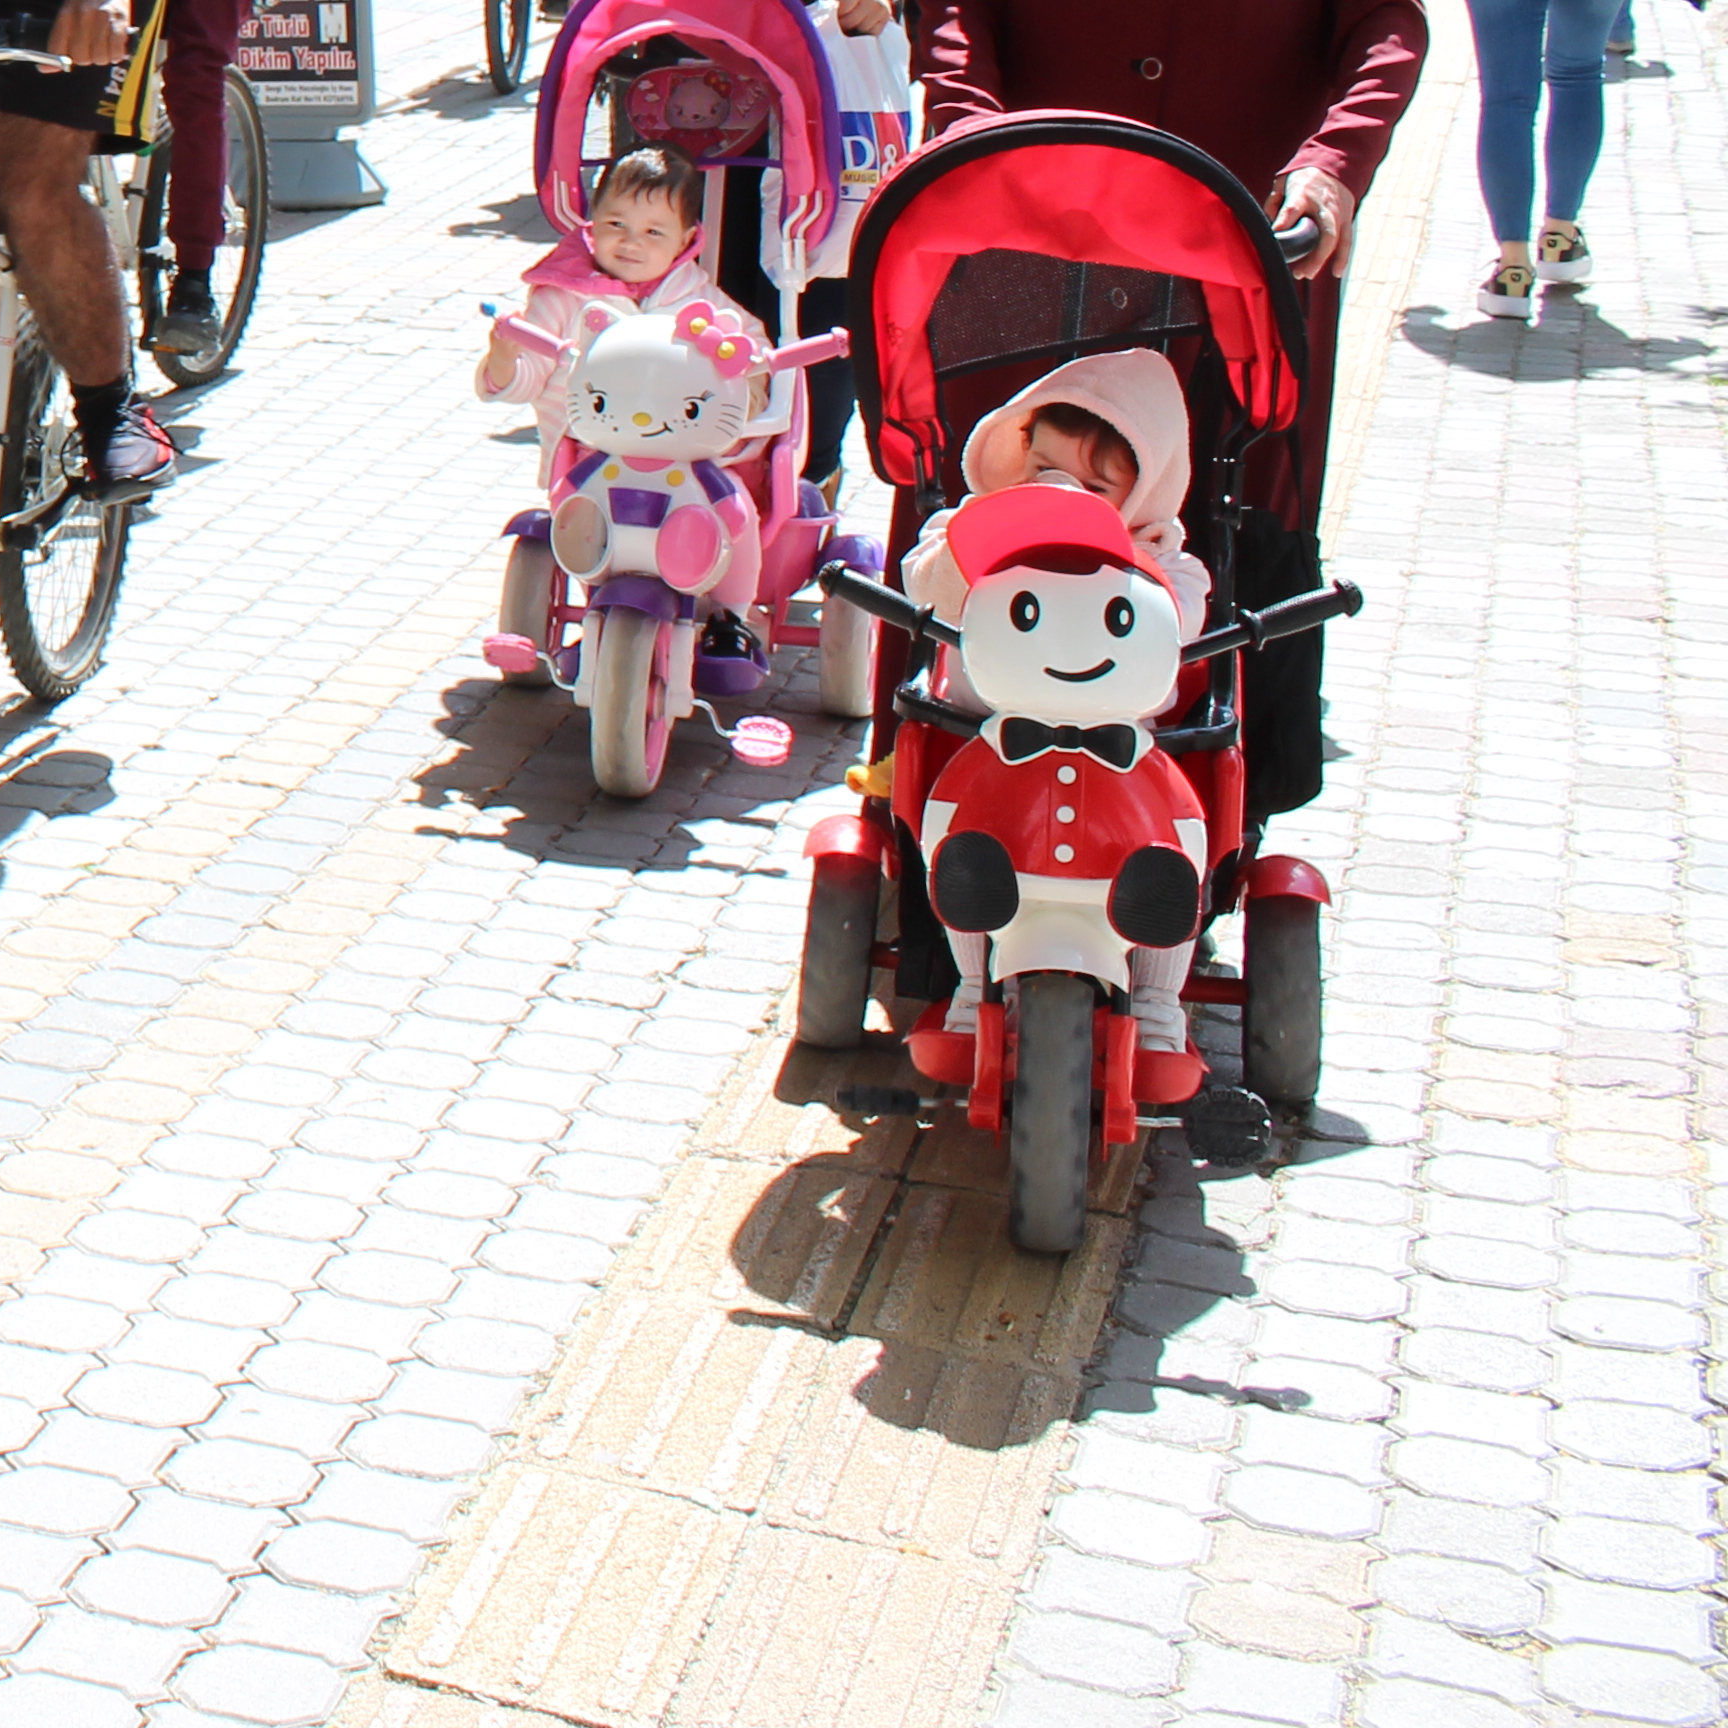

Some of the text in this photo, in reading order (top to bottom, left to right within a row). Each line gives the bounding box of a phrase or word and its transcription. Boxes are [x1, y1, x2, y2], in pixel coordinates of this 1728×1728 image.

[259, 13, 311, 39] Türlü
[238, 46, 357, 75] Dikim Yapılır.
[843, 172, 878, 184] MUSIC
